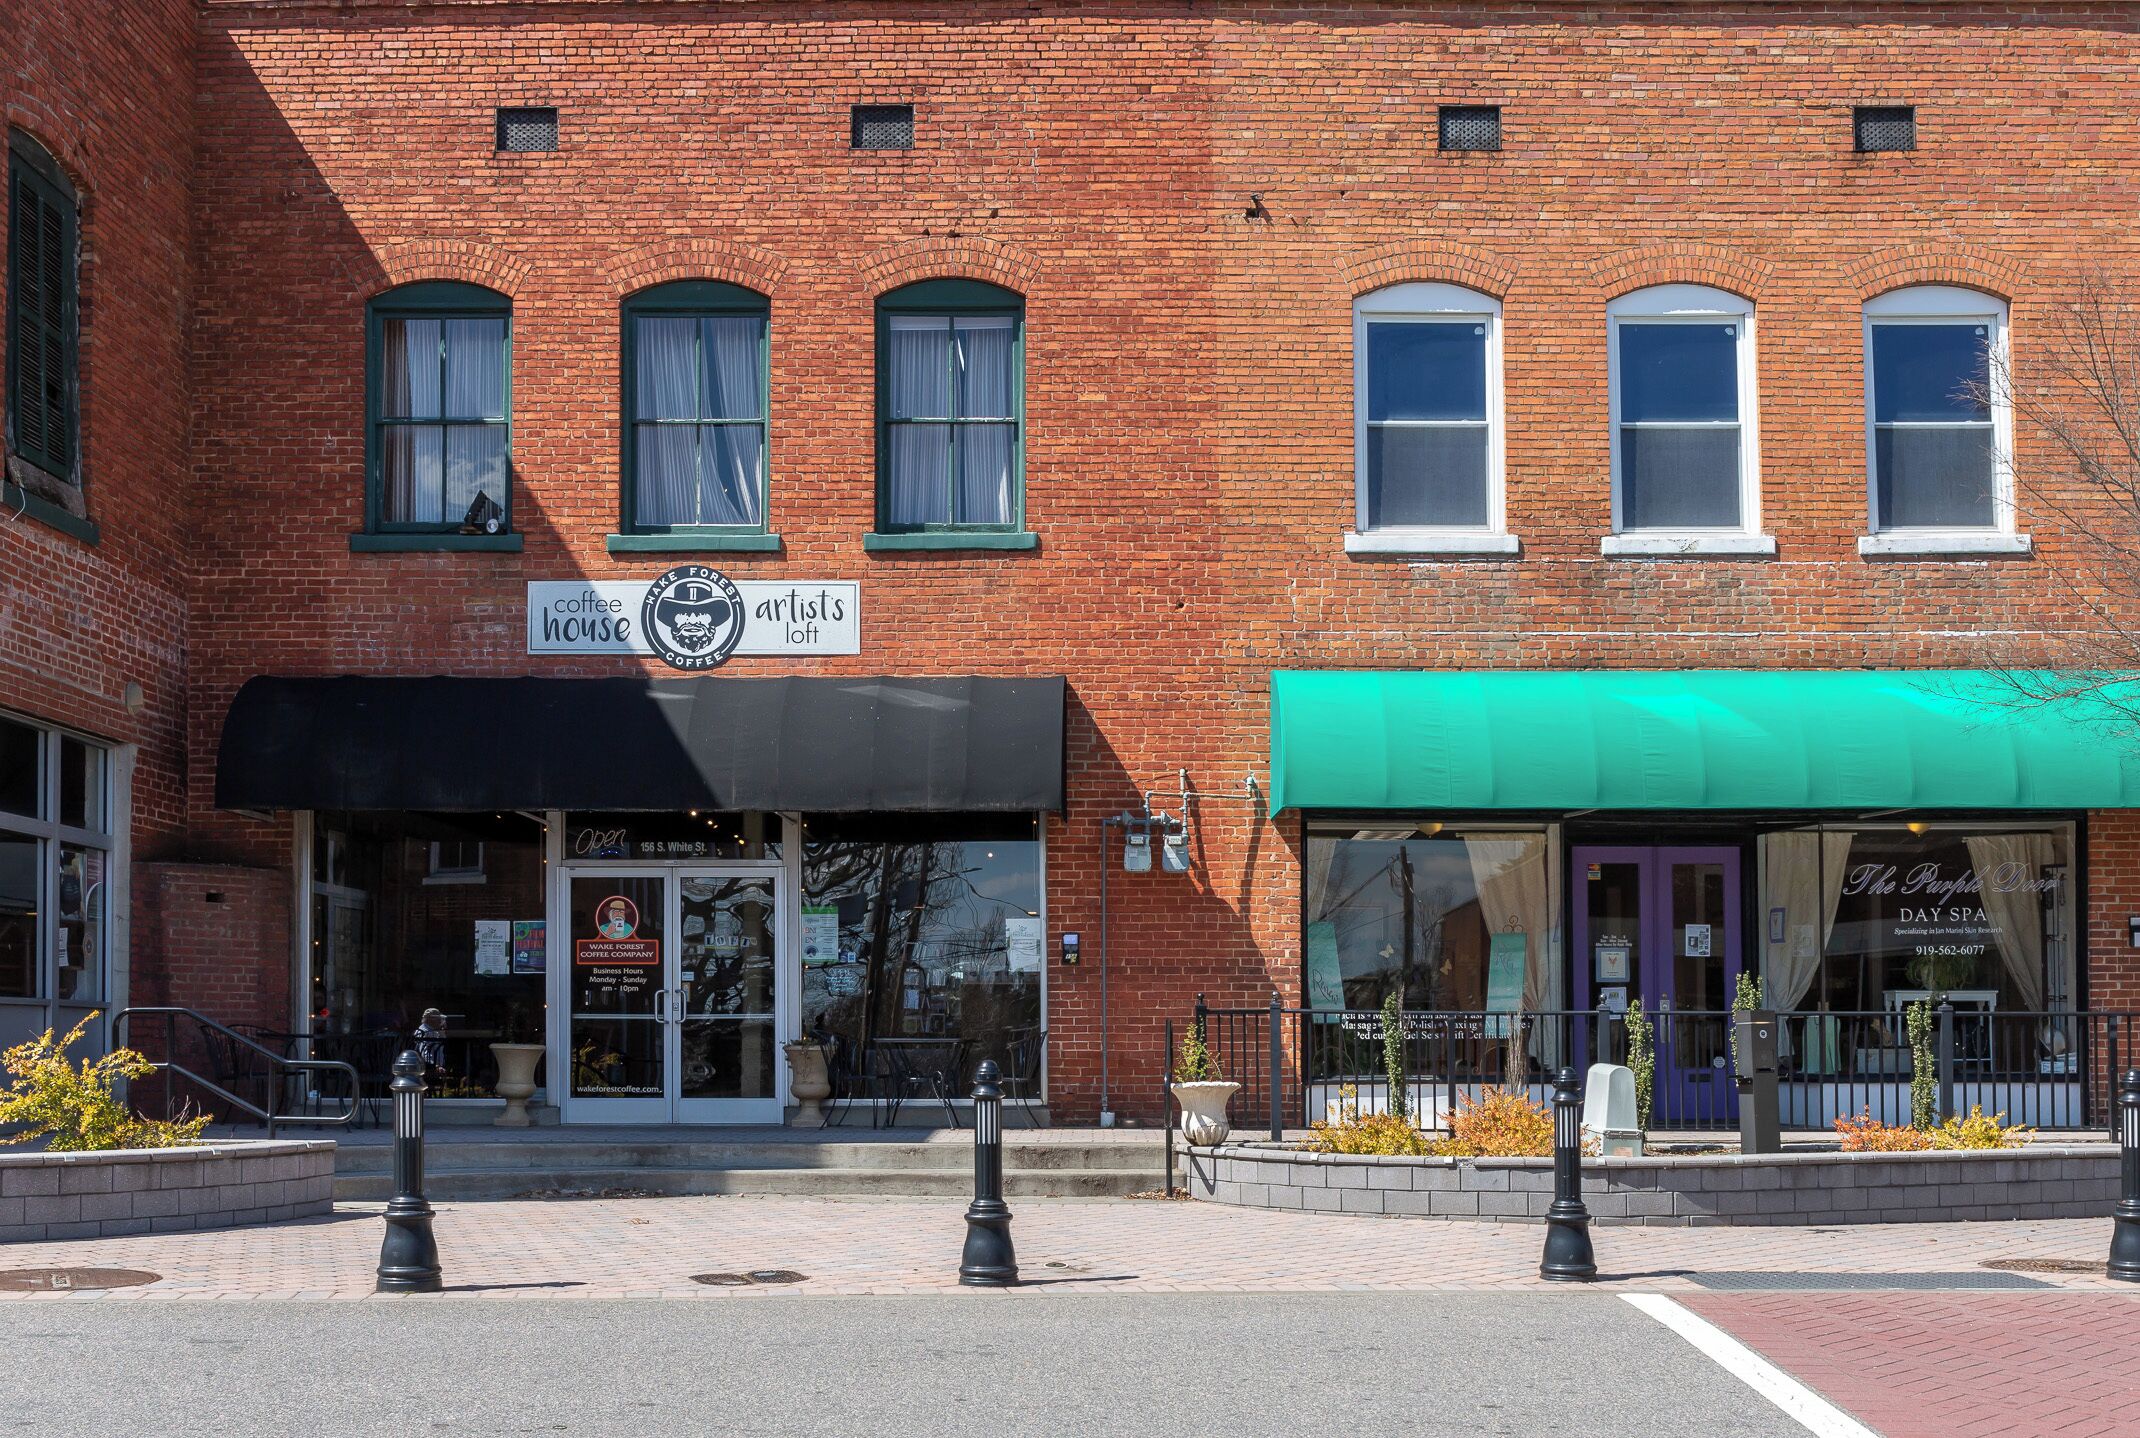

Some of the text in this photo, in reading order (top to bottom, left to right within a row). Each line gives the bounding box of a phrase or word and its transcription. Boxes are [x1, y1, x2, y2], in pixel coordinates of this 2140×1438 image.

[645, 567, 741, 606] WAKE FOREST
[554, 590, 622, 614] coffee
[543, 606, 631, 643] house
[786, 621, 820, 644] loft
[665, 650, 725, 668] COFFEE
[575, 827, 627, 854] Open
[640, 841, 708, 852] 156 S. White St.
[1842, 861, 2059, 906] The Purple Door
[1900, 907, 1988, 923] DAY SPA
[1894, 927, 1928, 935] Specializing
[1964, 926, 1977, 934] Skin
[1978, 926, 2003, 934] Research
[1916, 944, 1985, 956] 919-562-6077
[593, 967, 644, 975] Business Hours
[589, 976, 617, 984] Monday
[622, 976, 648, 984] Sunday
[1421, 1031, 1440, 1040] Ses
[576, 1084, 660, 1093] wakeforestcoffee.com
